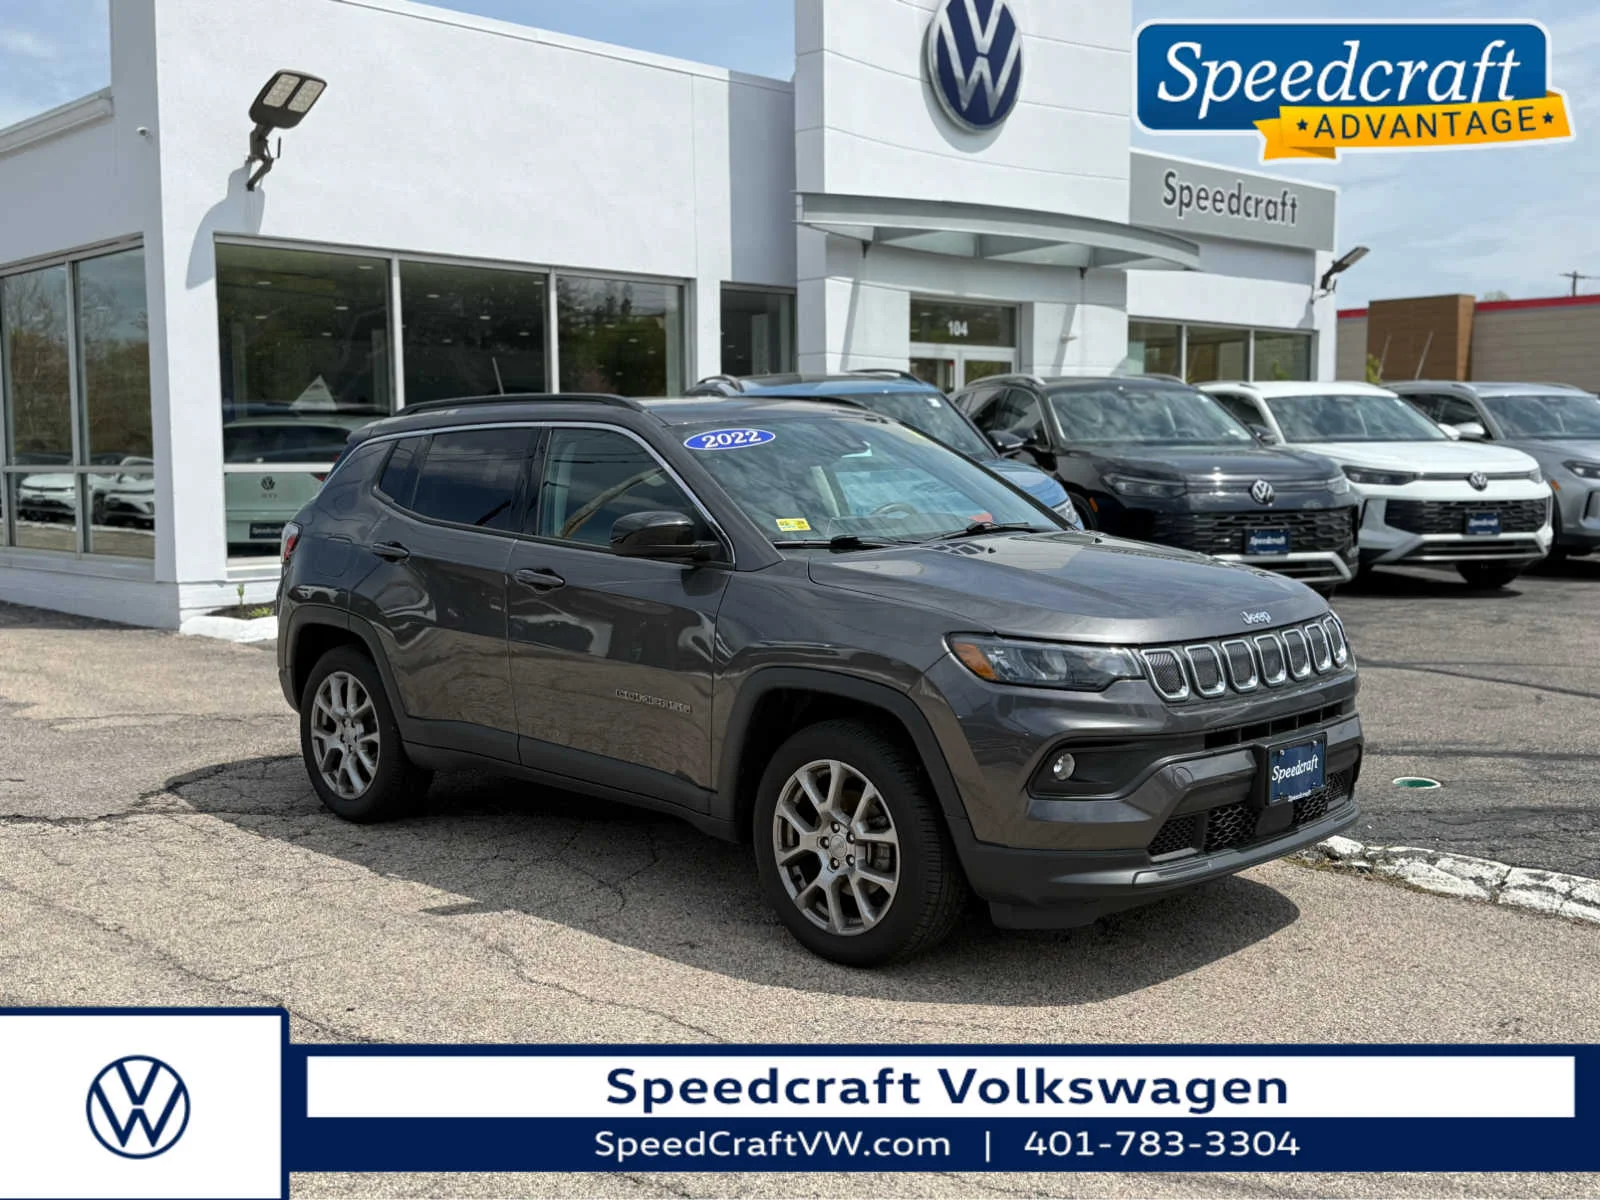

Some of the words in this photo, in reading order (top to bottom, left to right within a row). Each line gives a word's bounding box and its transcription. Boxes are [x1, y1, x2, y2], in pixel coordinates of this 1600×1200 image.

[1163, 170, 1298, 225] Speedcraft
[947, 320, 969, 336] 104
[701, 429, 762, 448] 2022
[1240, 610, 1272, 625] Jeep
[1271, 754, 1319, 784] Speedcraft
